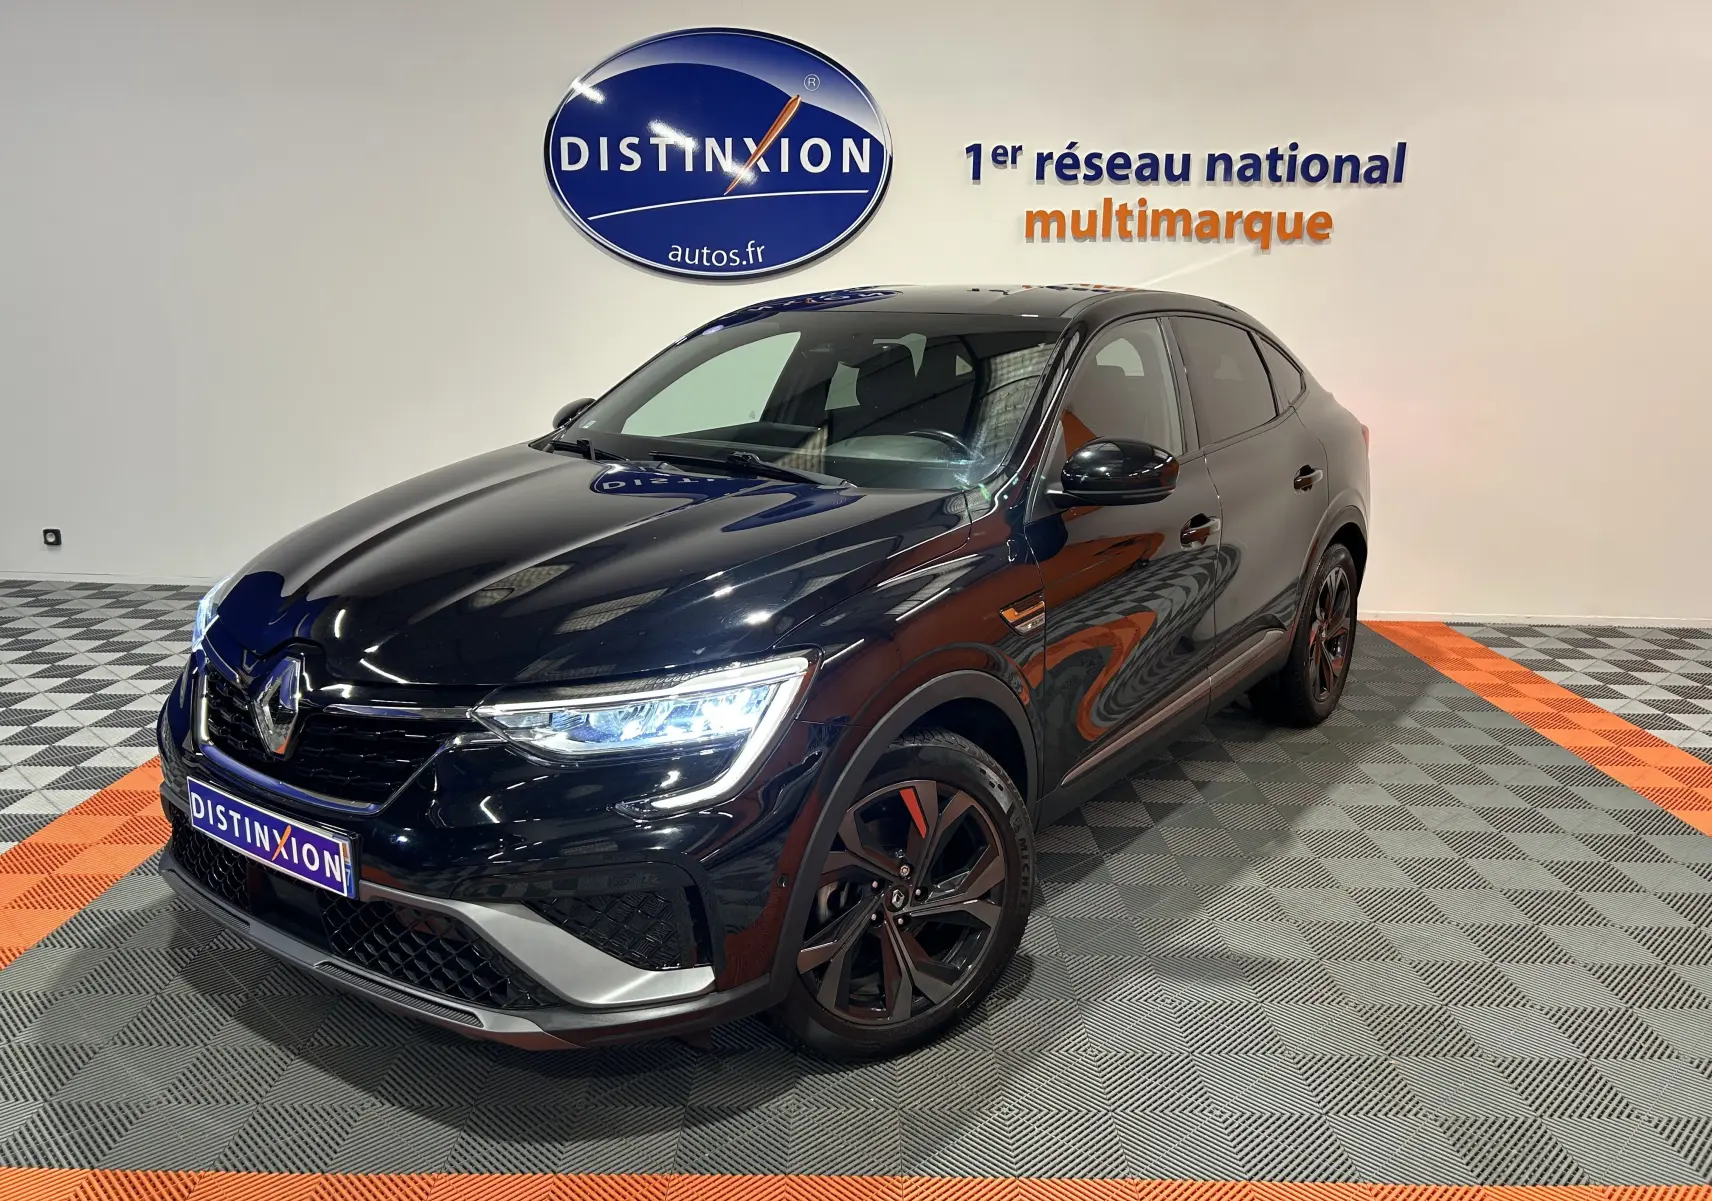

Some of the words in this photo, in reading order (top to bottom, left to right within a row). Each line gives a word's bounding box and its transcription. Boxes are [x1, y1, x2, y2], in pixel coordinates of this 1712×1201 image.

[560, 136, 871, 174] DISTINXION
[964, 142, 1023, 182] 1er
[1035, 141, 1191, 182] réseau
[1206, 142, 1407, 184] national
[1025, 197, 1334, 251] multimarque
[668, 240, 766, 267] autos.fr
[190, 791, 342, 883] DISTINXION
